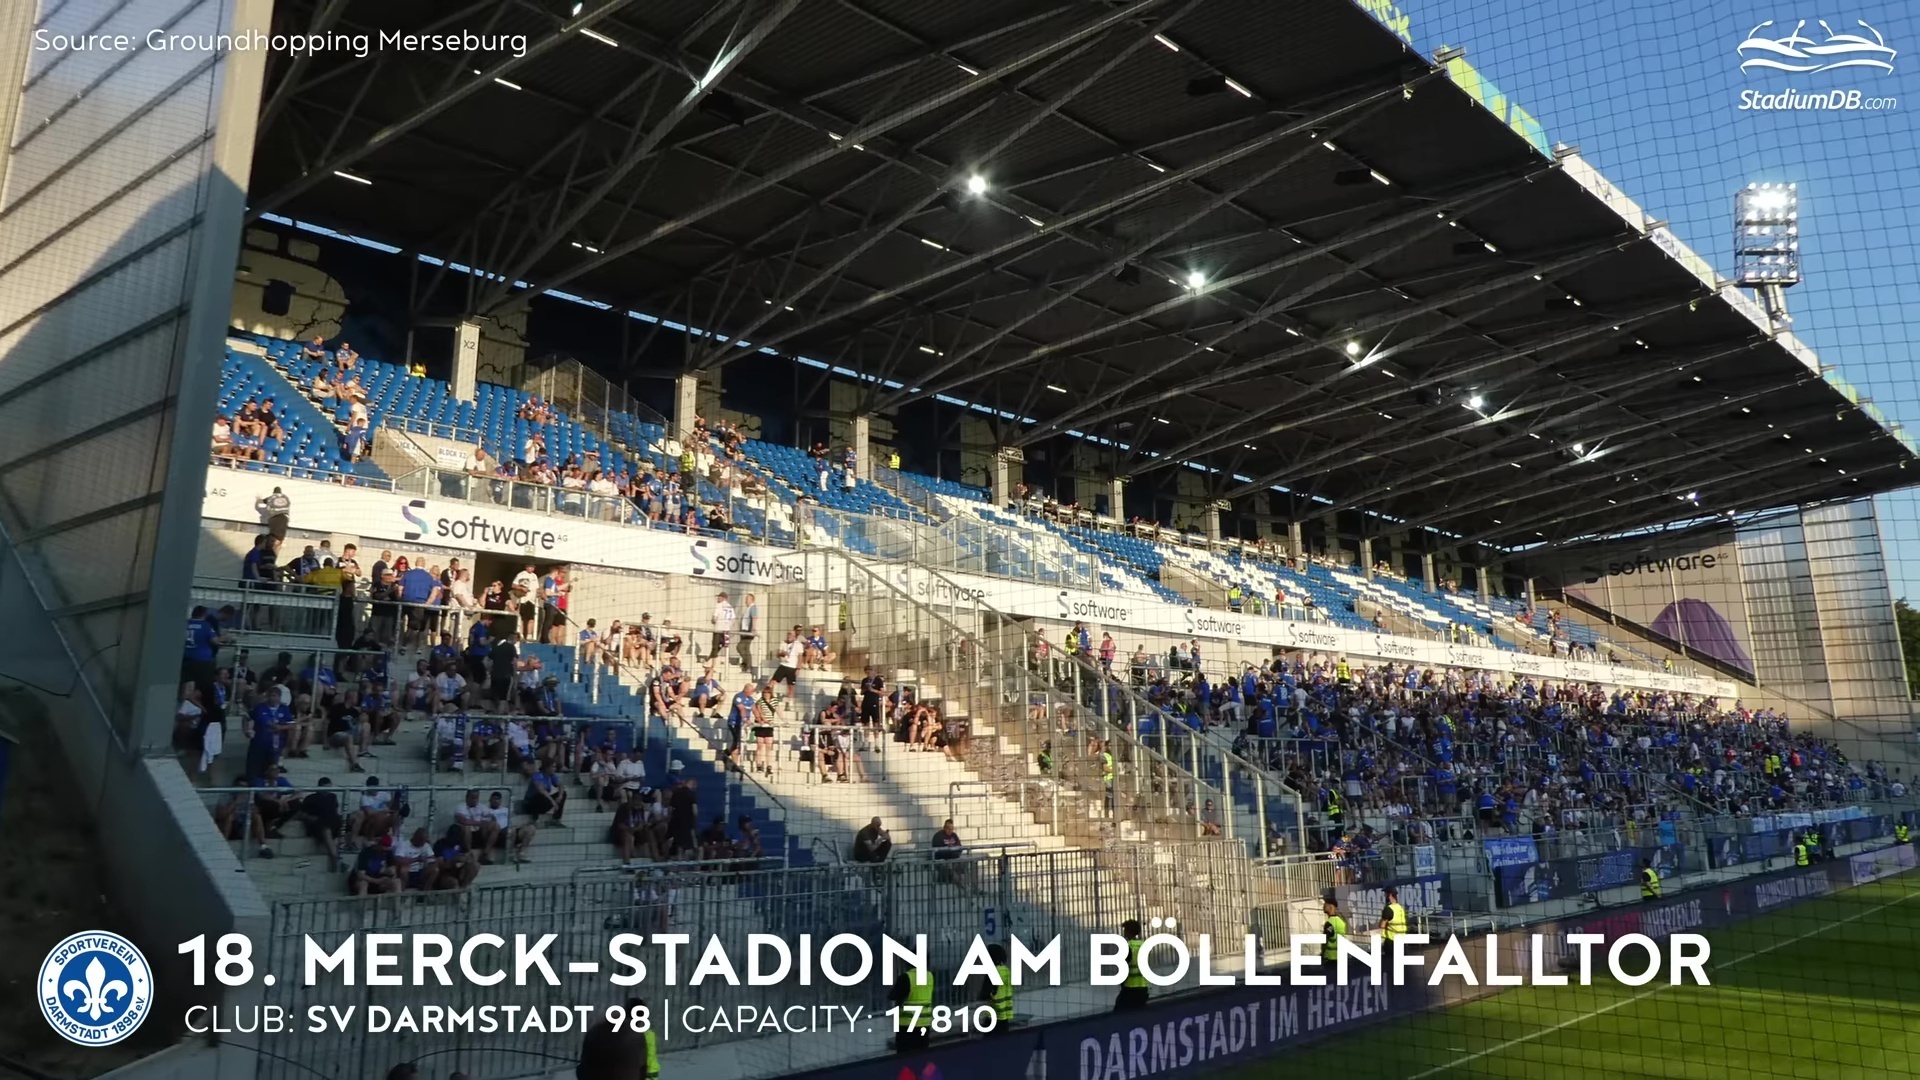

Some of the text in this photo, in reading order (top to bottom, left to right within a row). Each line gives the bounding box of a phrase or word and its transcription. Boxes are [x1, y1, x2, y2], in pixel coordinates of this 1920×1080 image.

[463, 339, 476, 350] X2
[210, 488, 228, 498] AG
[436, 515, 568, 551] software AG
[715, 553, 804, 581] software
[1608, 552, 1729, 577] software AG
[917, 578, 985, 602] software
[1073, 599, 1127, 621] software
[1197, 614, 1242, 636] software
[1298, 629, 1336, 647] software
[1383, 640, 1415, 657] software
[985, 908, 996, 936] 5
[1079, 971, 1389, 1080] DARMSTADT IM HERZEN
